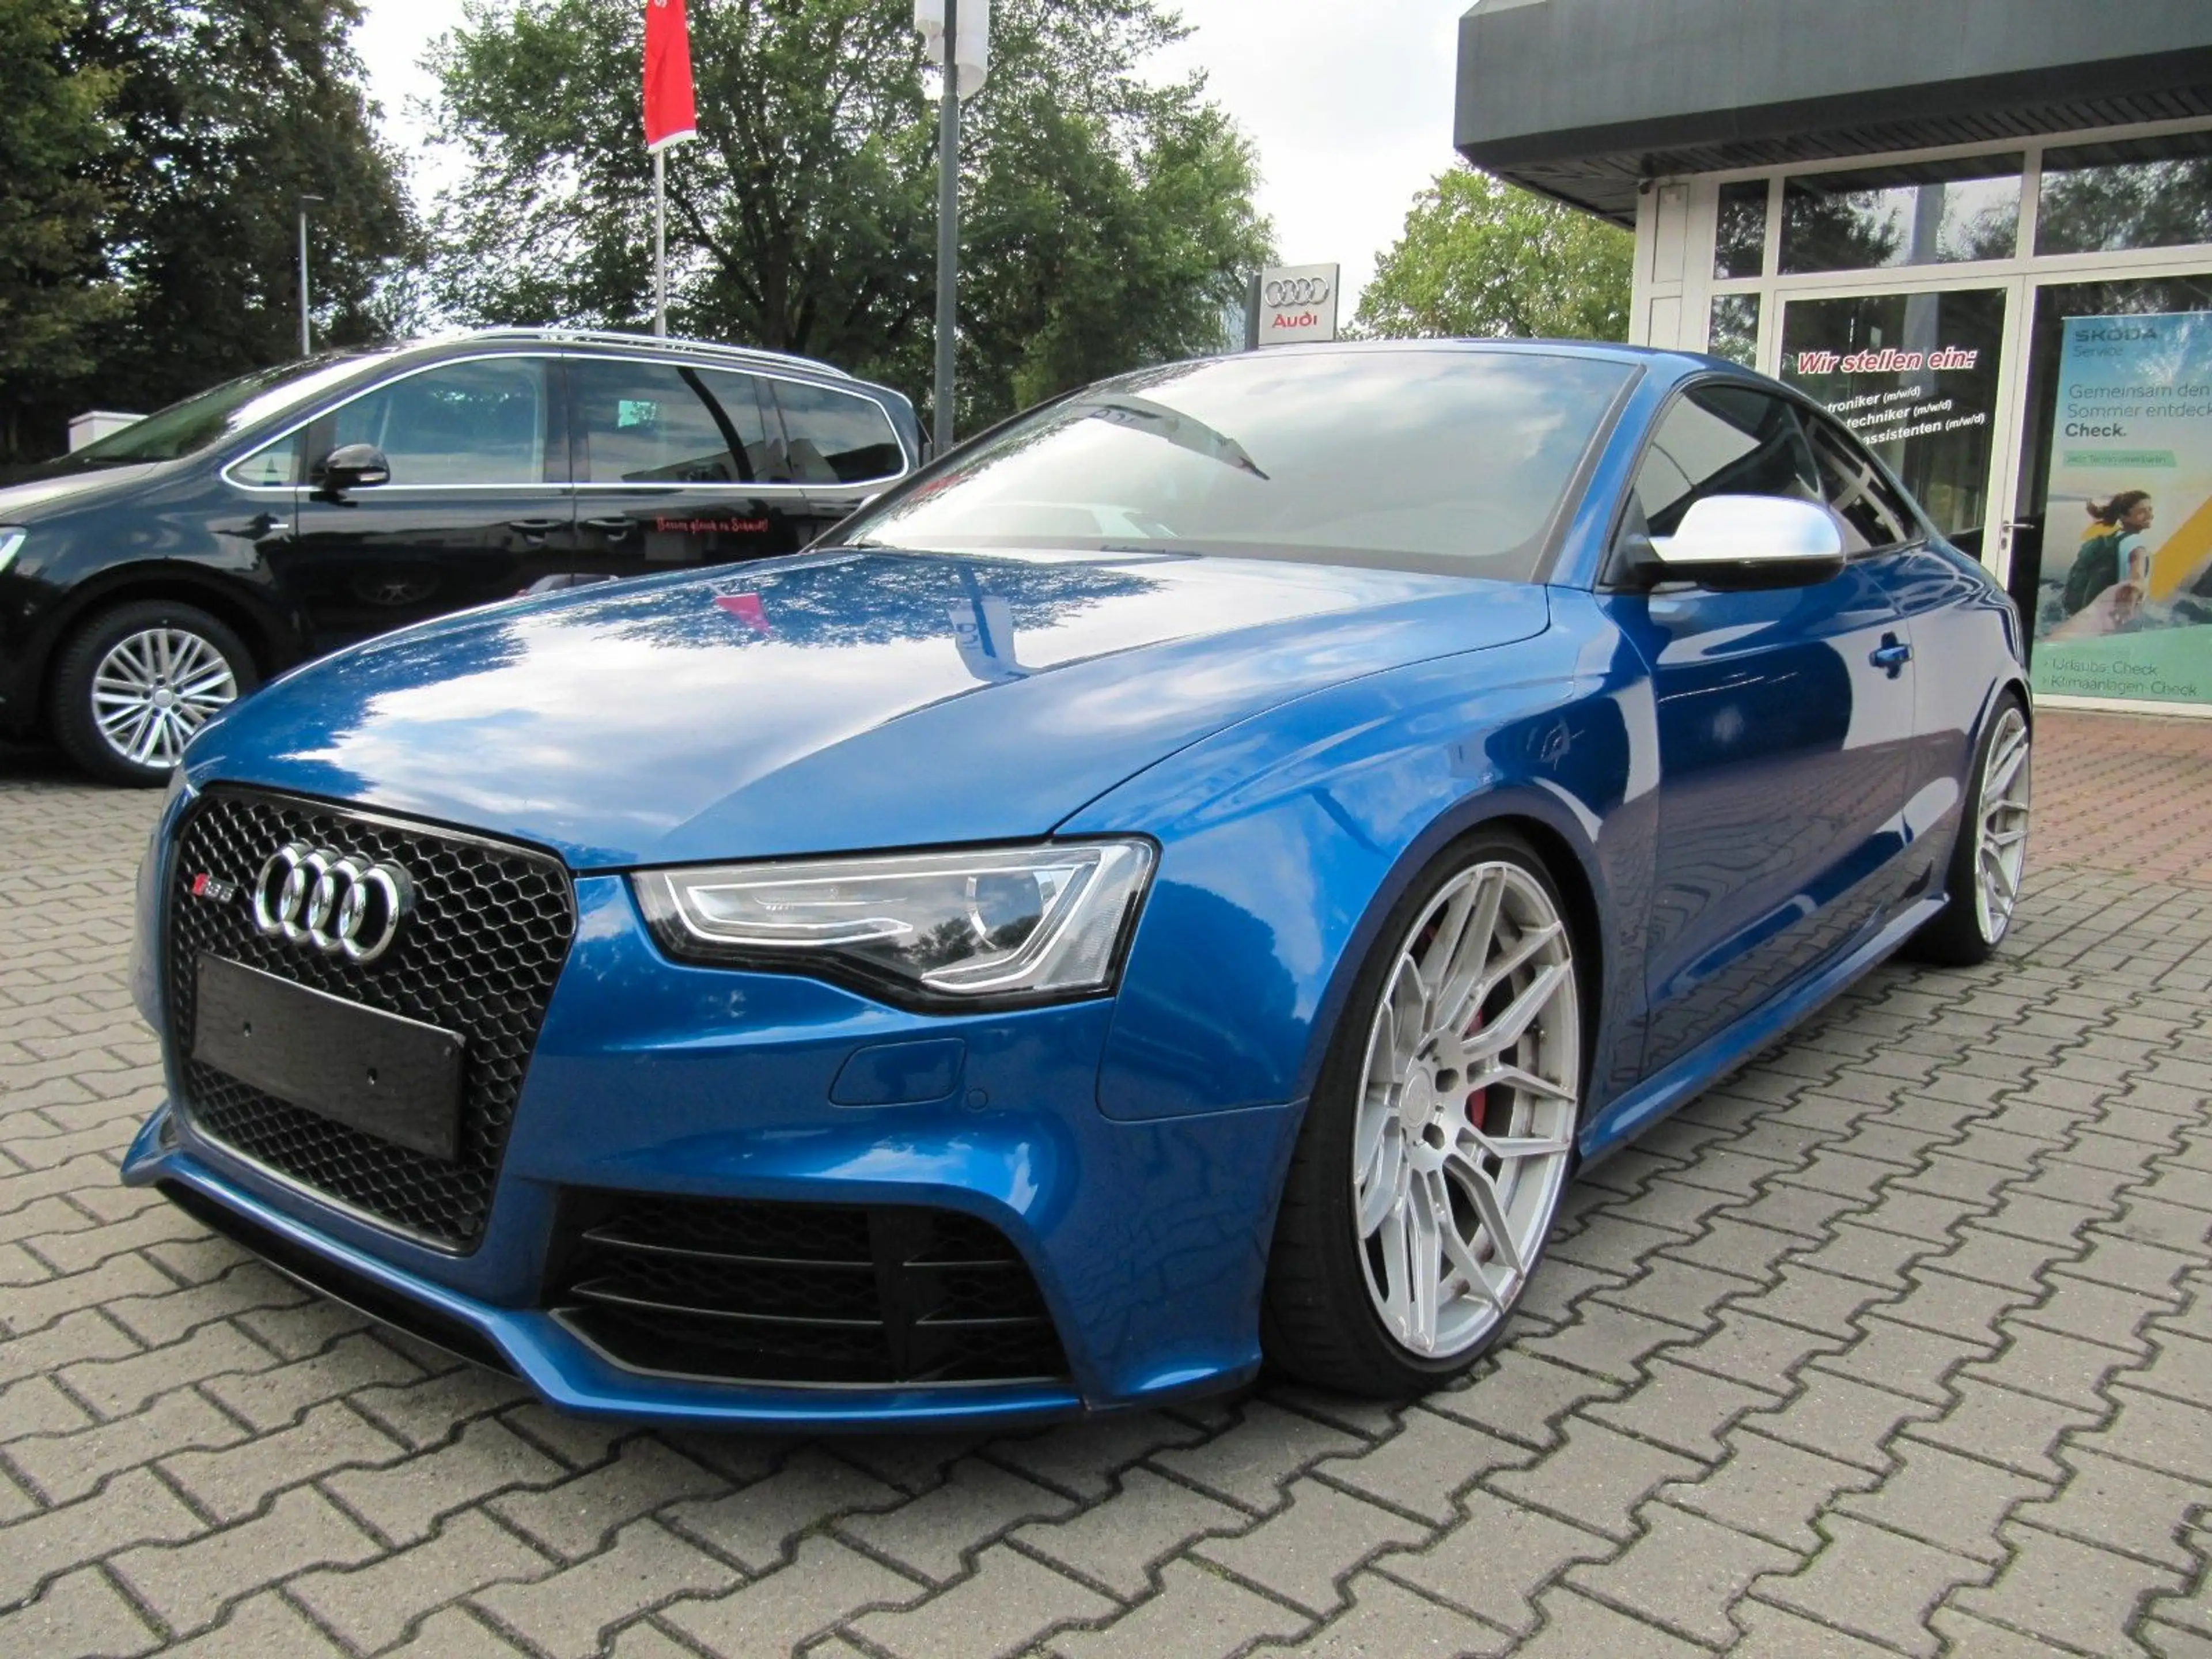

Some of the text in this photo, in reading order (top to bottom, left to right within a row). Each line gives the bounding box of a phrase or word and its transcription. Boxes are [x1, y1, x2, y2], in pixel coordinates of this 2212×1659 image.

[1272, 312, 1317, 328] Audi
[1798, 346, 1978, 374] Wir stellen ein:
[1883, 385, 1921, 404] (m/w/d)
[2069, 381, 2210, 399] Gemeinsam den
[1913, 399, 1952, 418] (m/w/d)
[2067, 403, 2142, 418] Sommer
[1862, 412, 1986, 445] assistenten (m/w/d)
[2065, 422, 2127, 437] Check.
